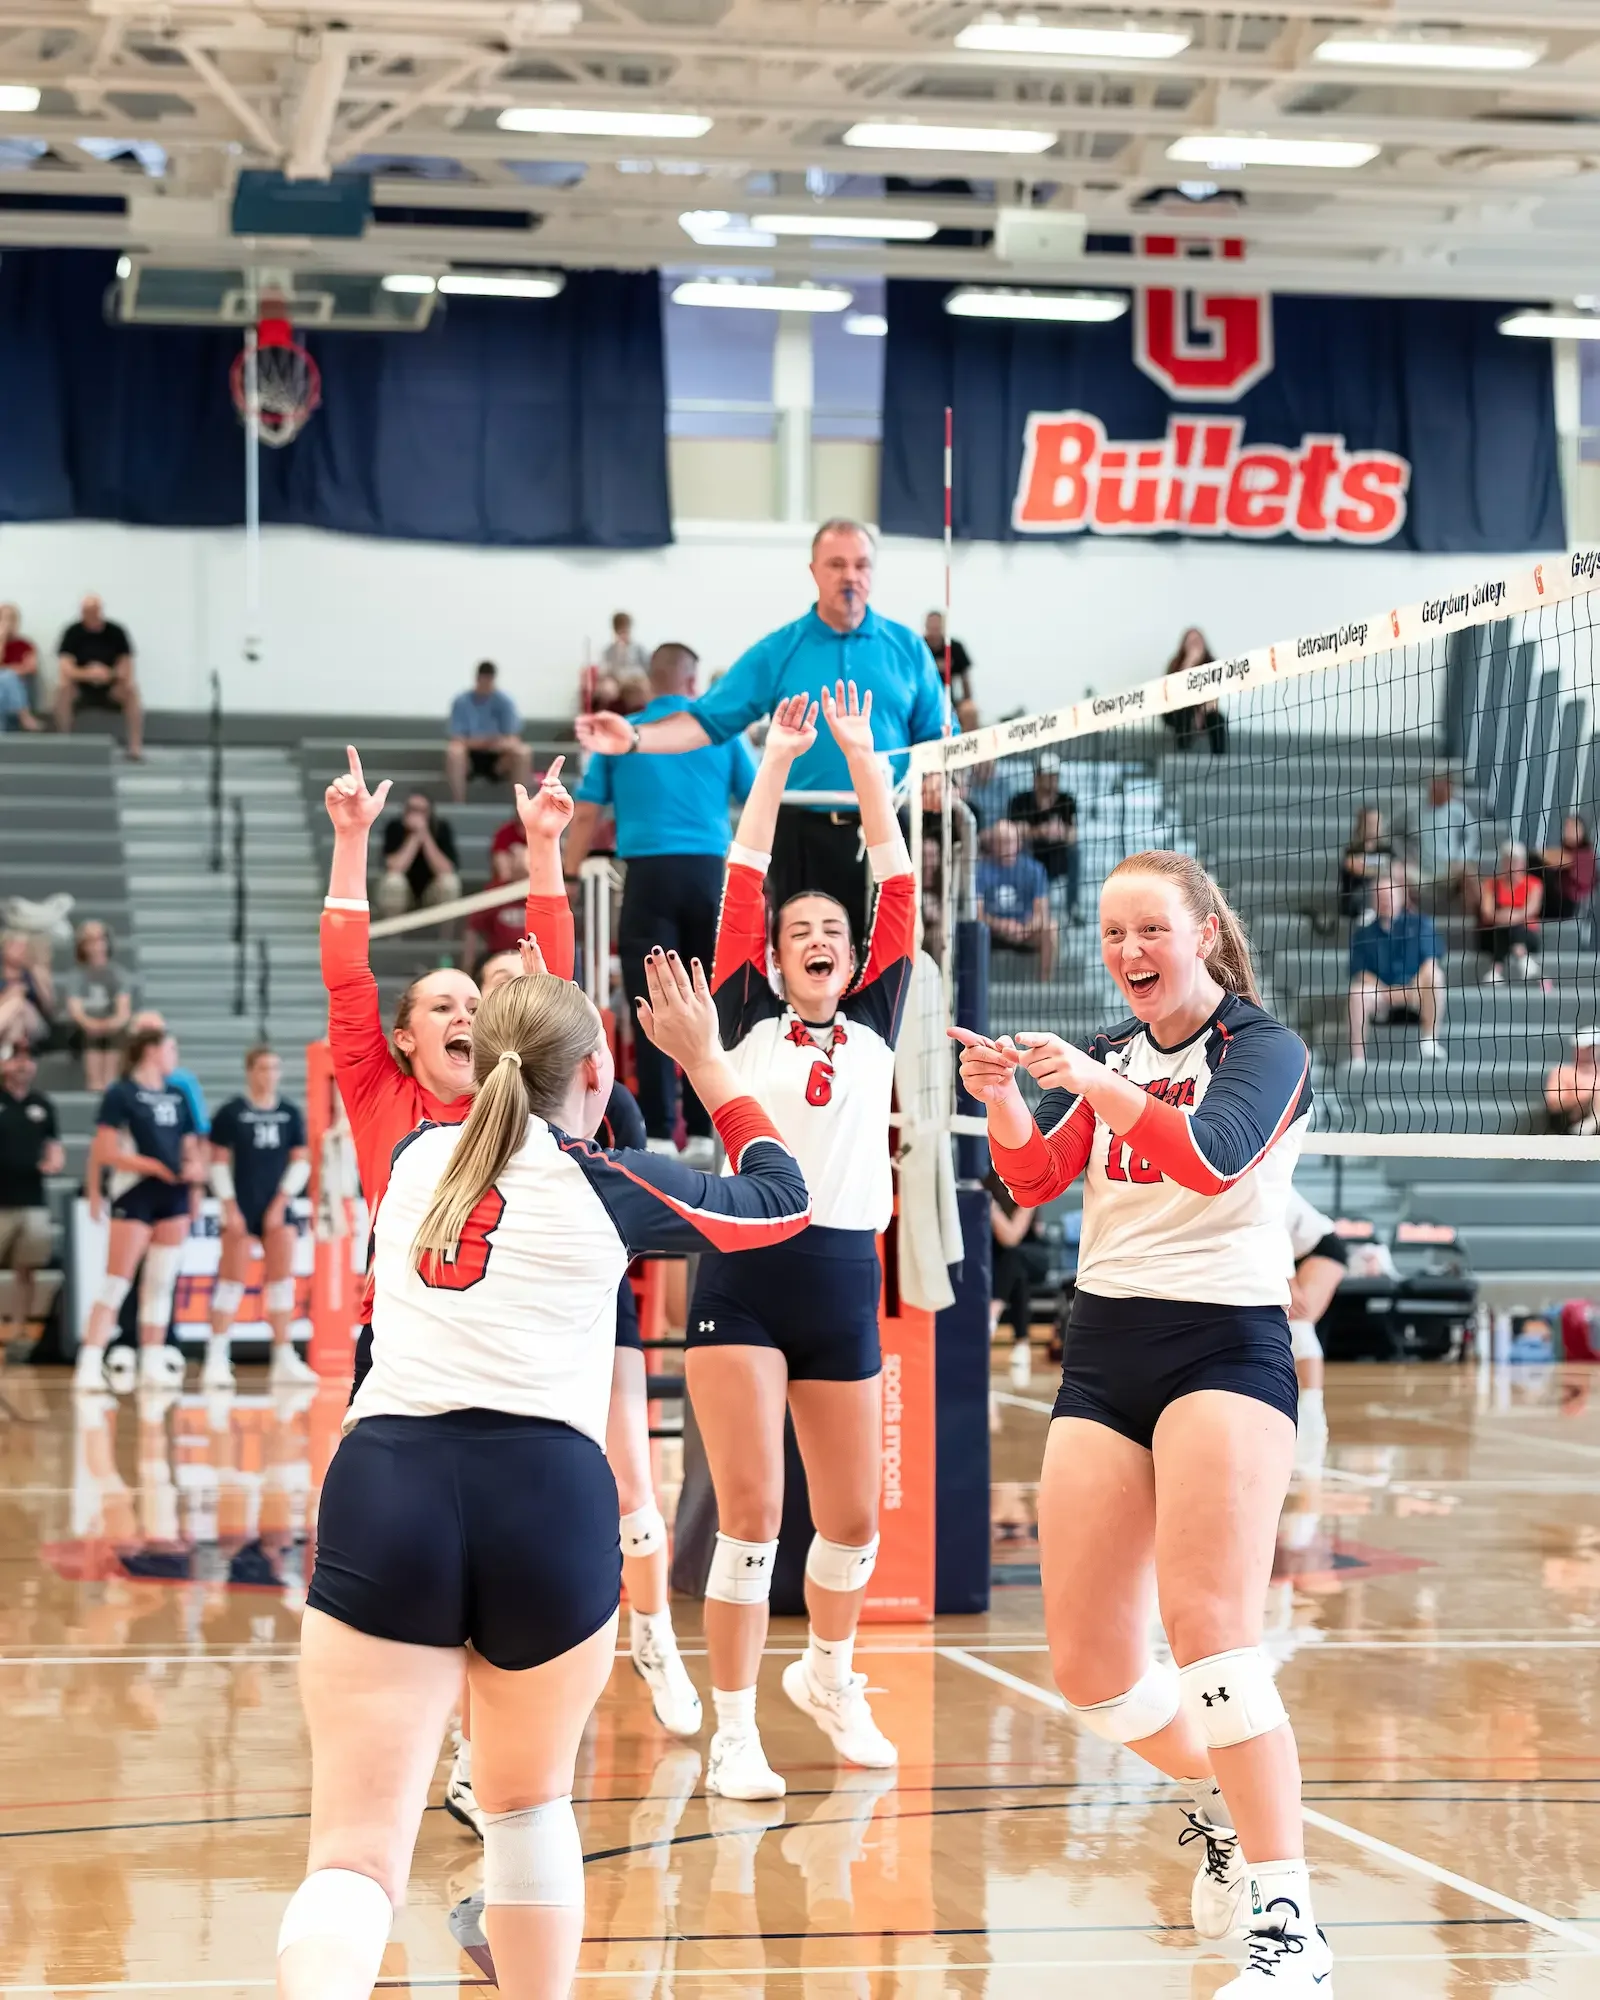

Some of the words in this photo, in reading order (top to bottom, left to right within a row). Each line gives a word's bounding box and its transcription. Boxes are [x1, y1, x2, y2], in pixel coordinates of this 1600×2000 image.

[1132, 230, 1276, 402] G
[1013, 410, 1411, 544] Bullets
[1472, 579, 1506, 607] College
[805, 1060, 835, 1107] 6
[415, 1183, 507, 1292] 3
[882, 1353, 904, 1423] sports
